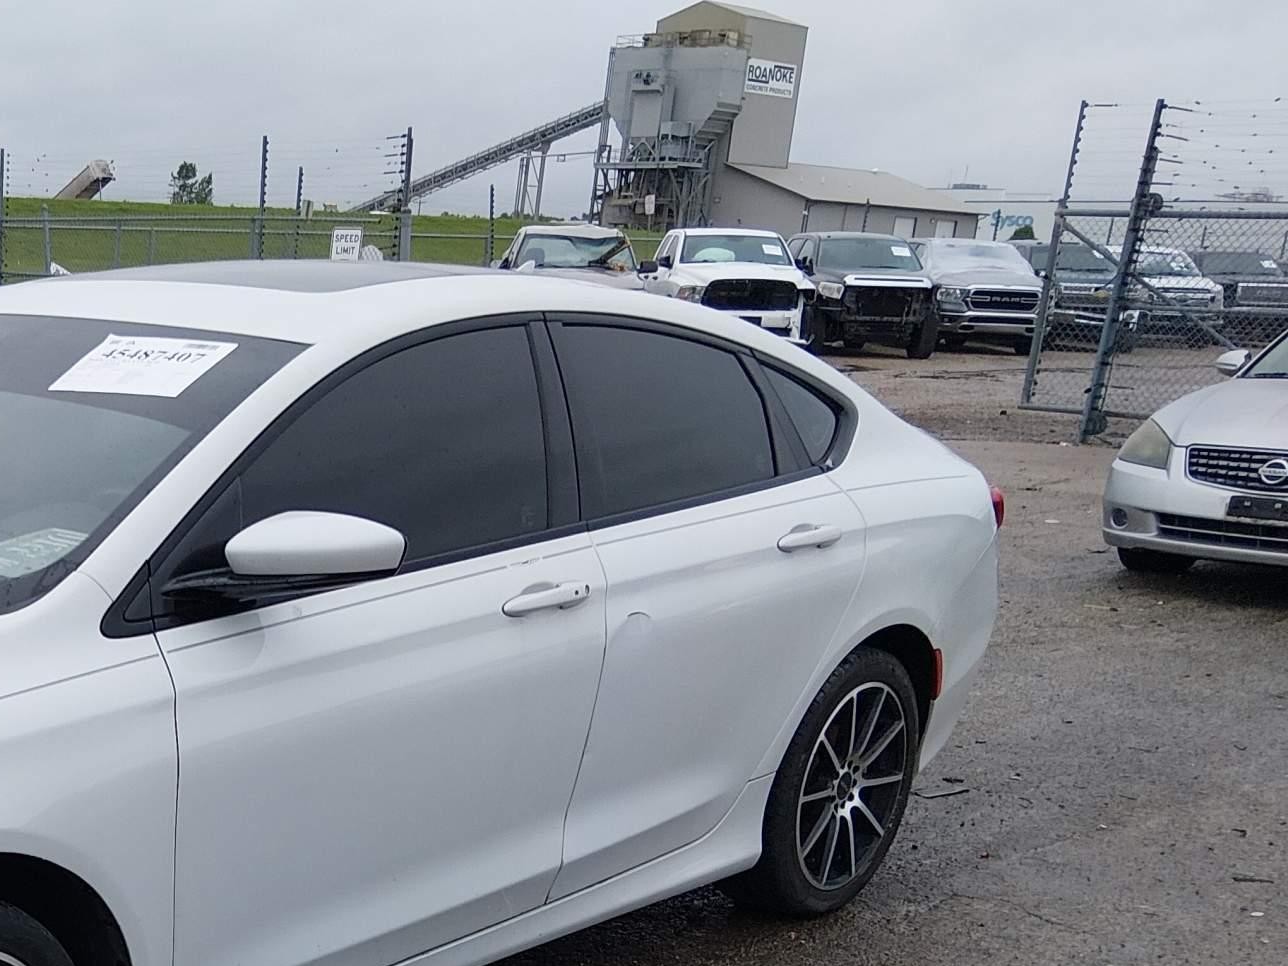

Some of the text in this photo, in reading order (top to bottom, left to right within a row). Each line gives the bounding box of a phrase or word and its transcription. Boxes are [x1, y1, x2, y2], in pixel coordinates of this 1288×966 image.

[748, 64, 794, 84] ROANOKE
[335, 234, 360, 243] SPEED
[335, 246, 356, 255] LIMIT
[102, 348, 207, 364] 45487407
